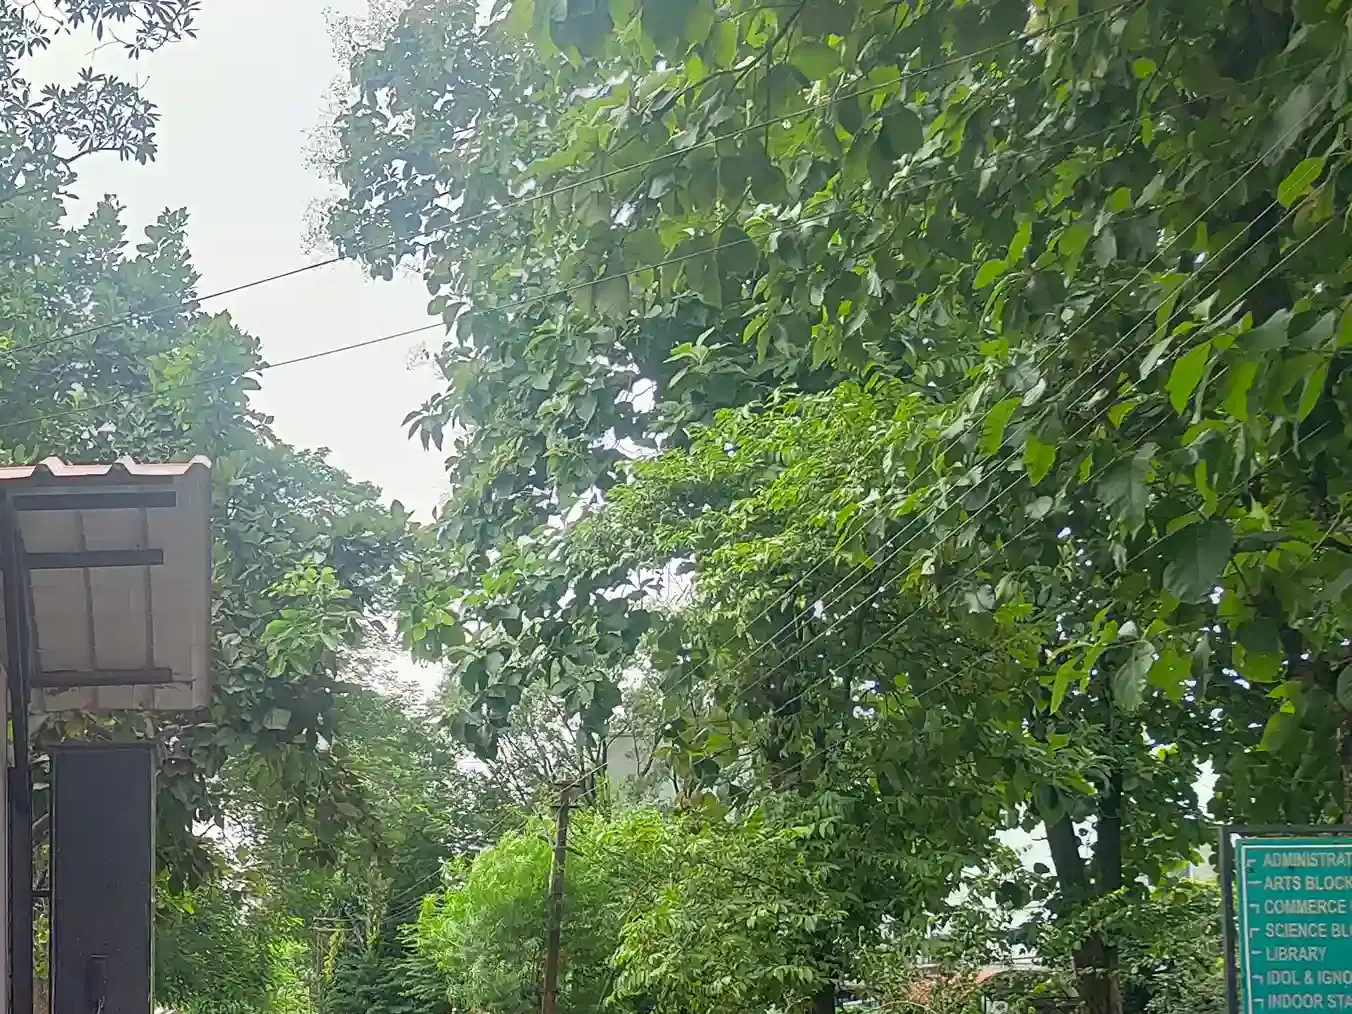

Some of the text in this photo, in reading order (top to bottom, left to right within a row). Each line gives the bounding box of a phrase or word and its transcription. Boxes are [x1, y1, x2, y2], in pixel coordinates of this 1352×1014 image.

[1264, 875, 1352, 891] ARTS BLOCK
[1264, 899, 1347, 914] COMMERCE
[1266, 922, 1352, 938] SCIENCE BL
[1266, 946, 1327, 962] LIBRARY
[1267, 970, 1300, 985] IDOL
[1304, 970, 1314, 985] &
[1268, 994, 1323, 1009] INDOOR
